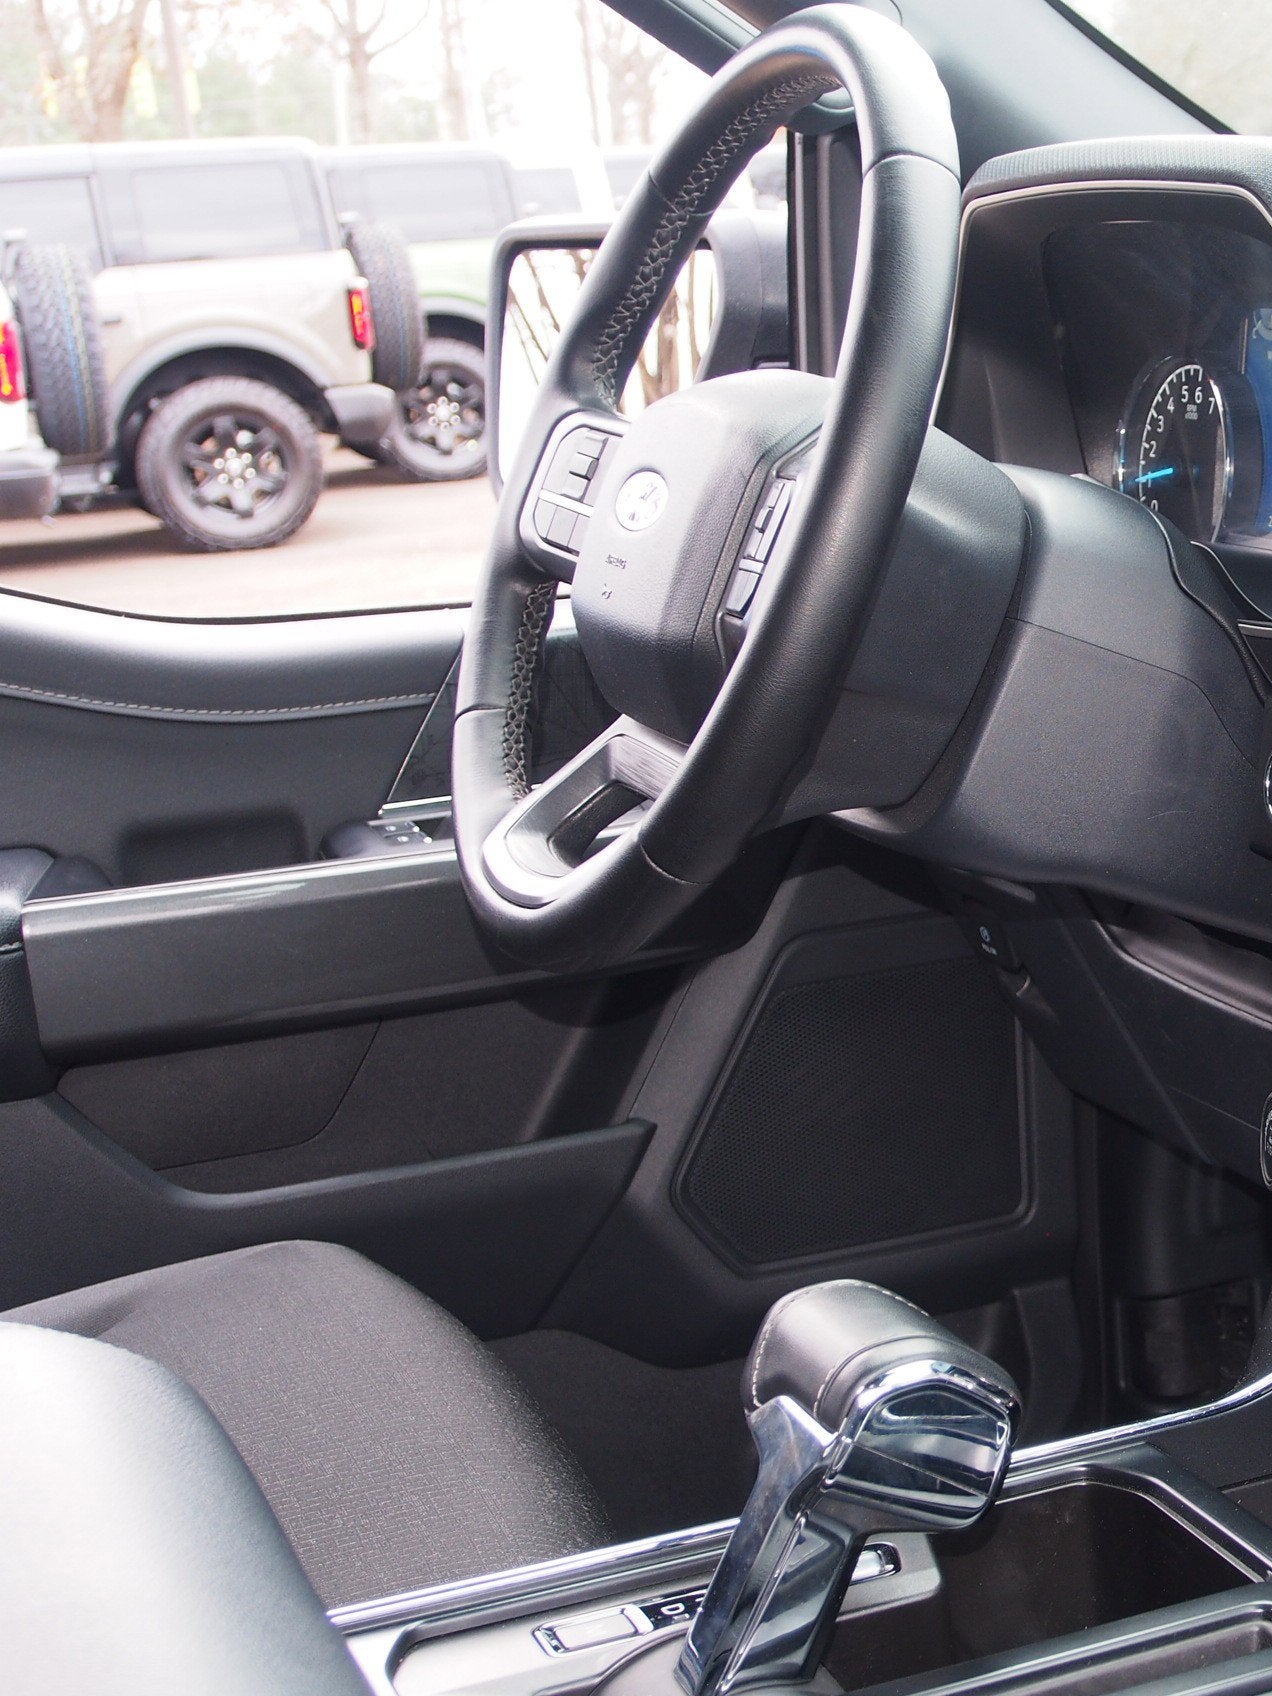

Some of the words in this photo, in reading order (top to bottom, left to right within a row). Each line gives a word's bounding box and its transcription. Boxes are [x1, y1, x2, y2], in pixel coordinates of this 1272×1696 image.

[1181, 386, 1189, 403] 5
[1195, 387, 1203, 404] 6
[1167, 397, 1175, 413] 4
[1208, 398, 1216, 414] 7
[1156, 416, 1165, 432] 3
[1149, 441, 1156, 458] 2
